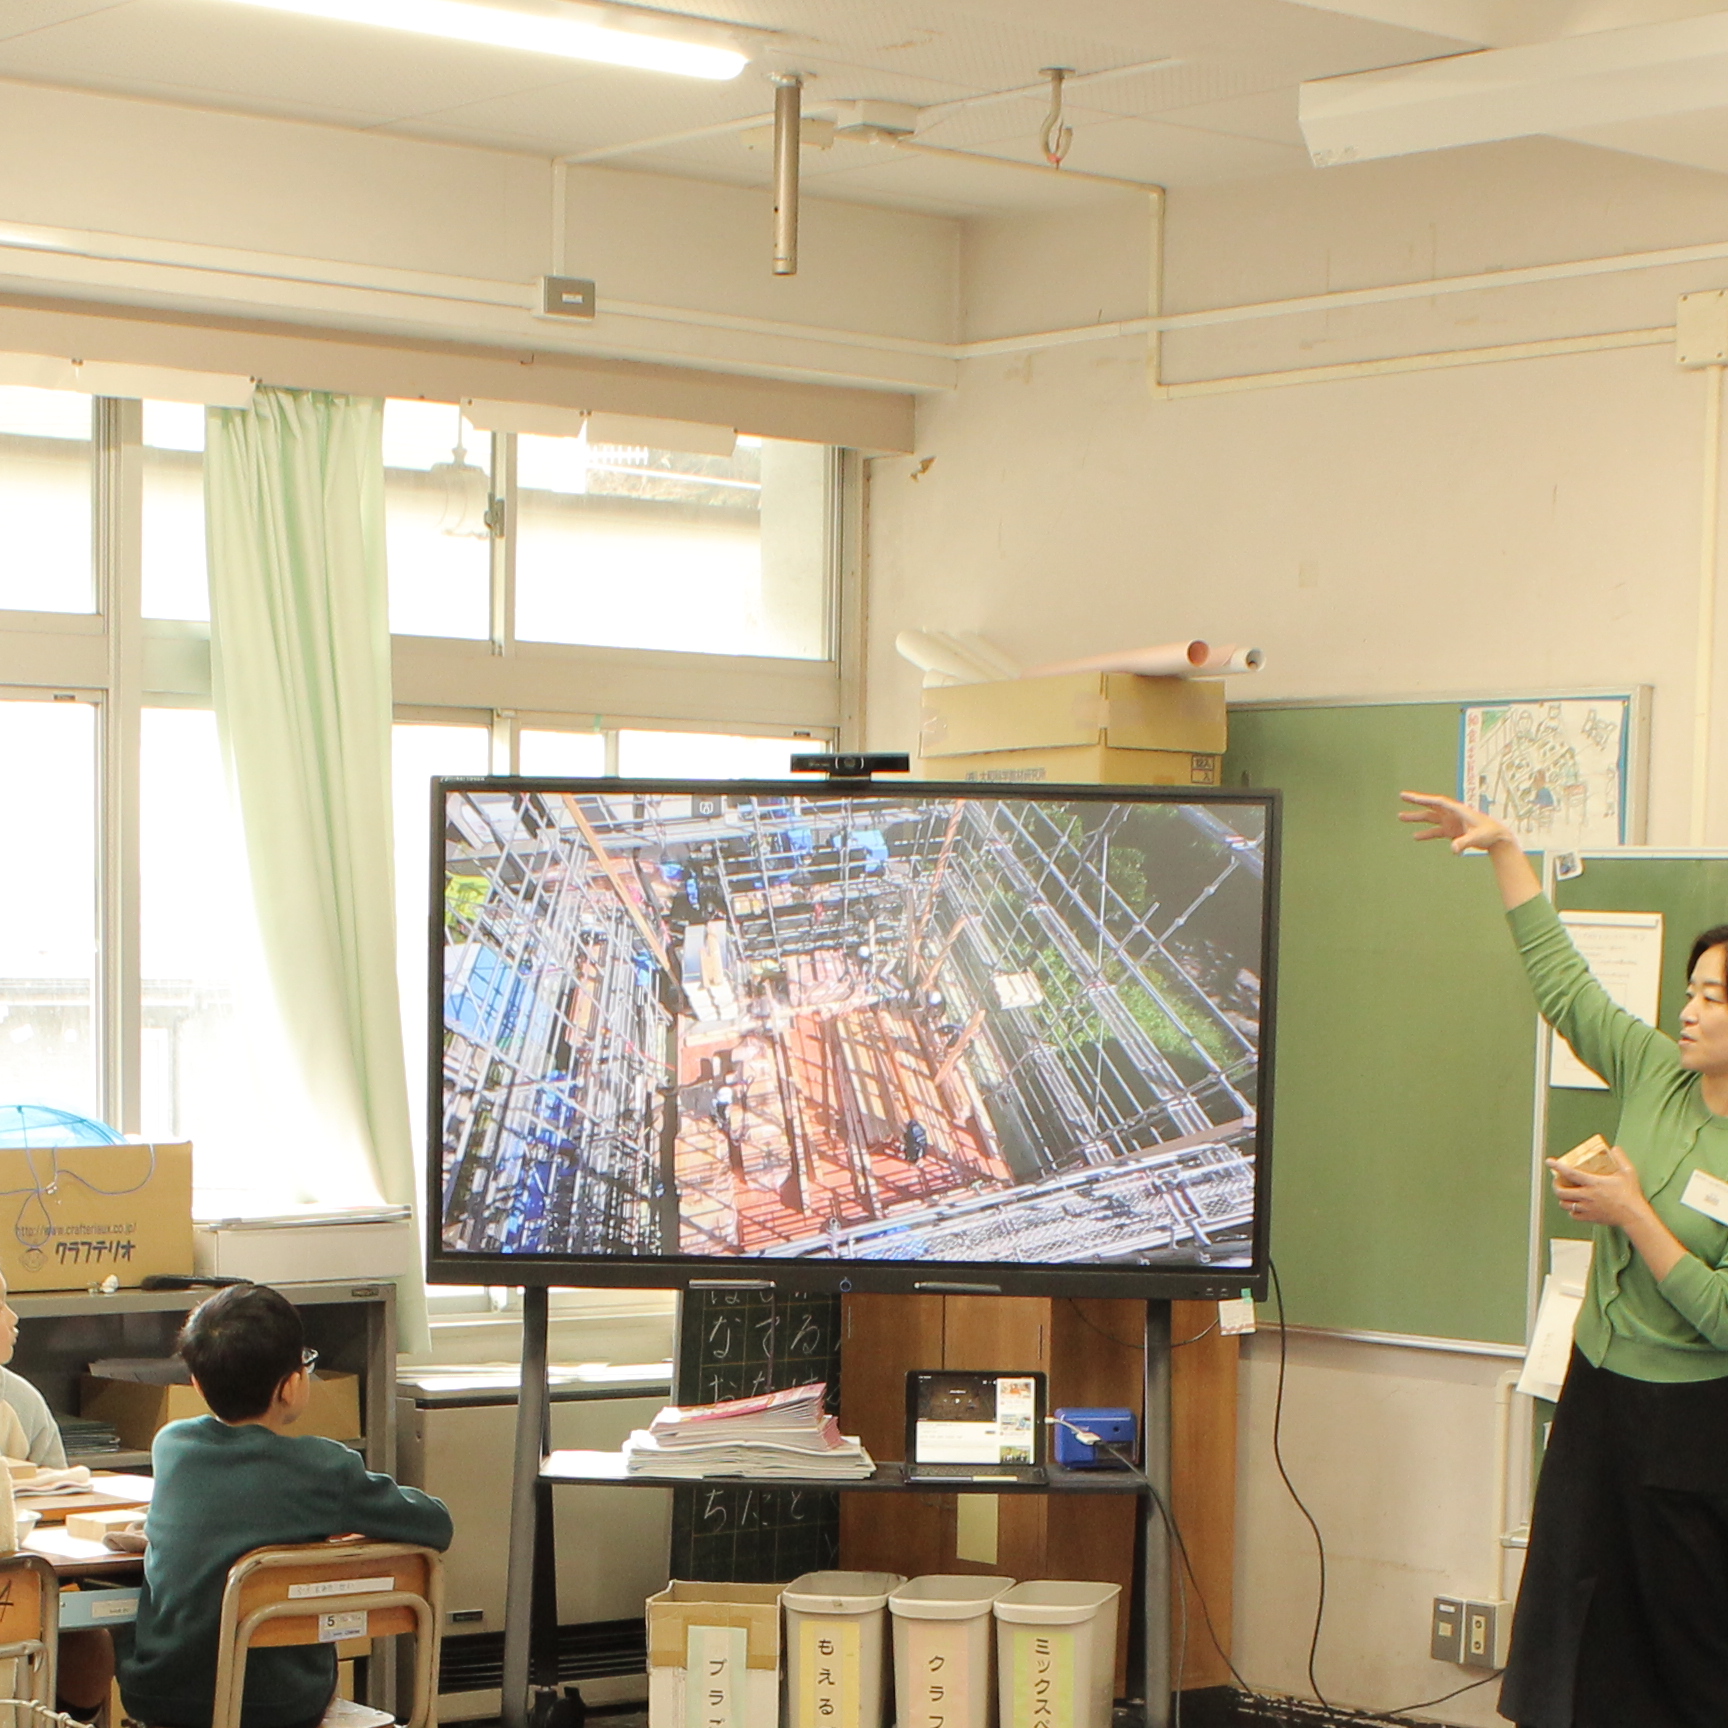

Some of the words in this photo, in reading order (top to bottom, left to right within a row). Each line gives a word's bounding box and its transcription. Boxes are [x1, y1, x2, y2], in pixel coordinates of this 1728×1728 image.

[55, 1240, 136, 1265] クラフテリオ
[326, 1615, 336, 1627] 5
